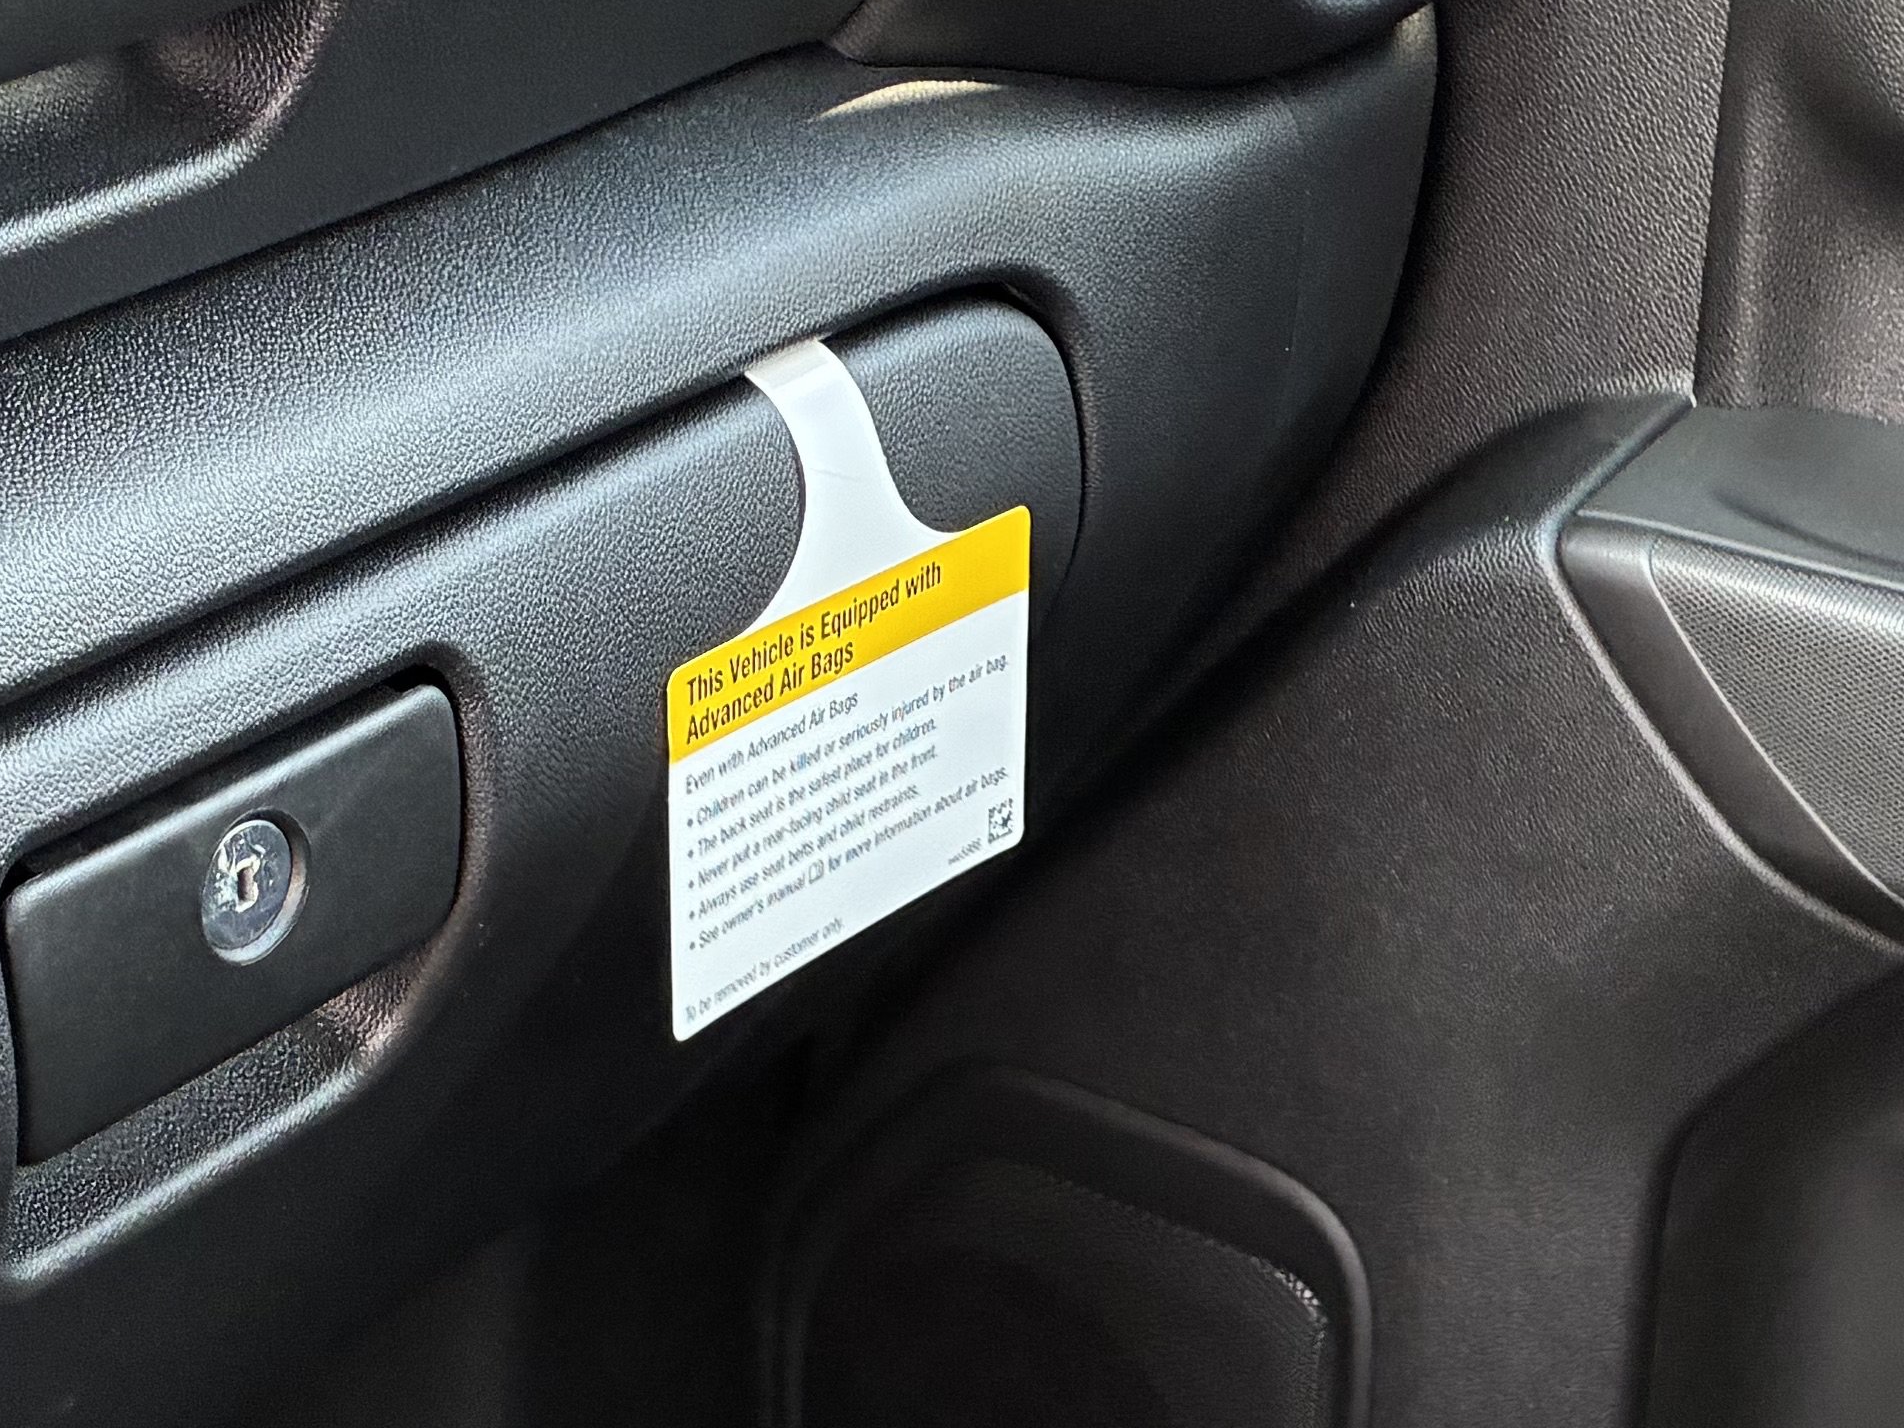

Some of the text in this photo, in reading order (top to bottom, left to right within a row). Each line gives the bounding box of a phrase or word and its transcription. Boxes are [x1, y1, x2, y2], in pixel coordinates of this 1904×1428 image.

[686, 561, 942, 706] This Vehicle is Equipped with
[685, 692, 859, 796] Even with Advanced Air Bags
[686, 641, 854, 745] Advanced Air Bags
[696, 654, 1009, 826] Children can be killed or seriously injured by the air bag.
[697, 834, 718, 857] The
[719, 816, 748, 845] back
[748, 800, 774, 828] seat
[775, 795, 786, 813] is
[787, 785, 806, 807] the
[807, 764, 842, 797] safest
[843, 750, 873, 781] place
[875, 740, 891, 760] for
[697, 858, 730, 888] Never
[731, 843, 751, 872] put
[751, 840, 761, 857] a
[825, 788, 852, 816] child
[853, 774, 877, 802] seat
[890, 760, 909, 781] the
[698, 884, 738, 919] Always
[761, 854, 786, 882] seat
[816, 825, 838, 851] and
[698, 925, 720, 949] See
